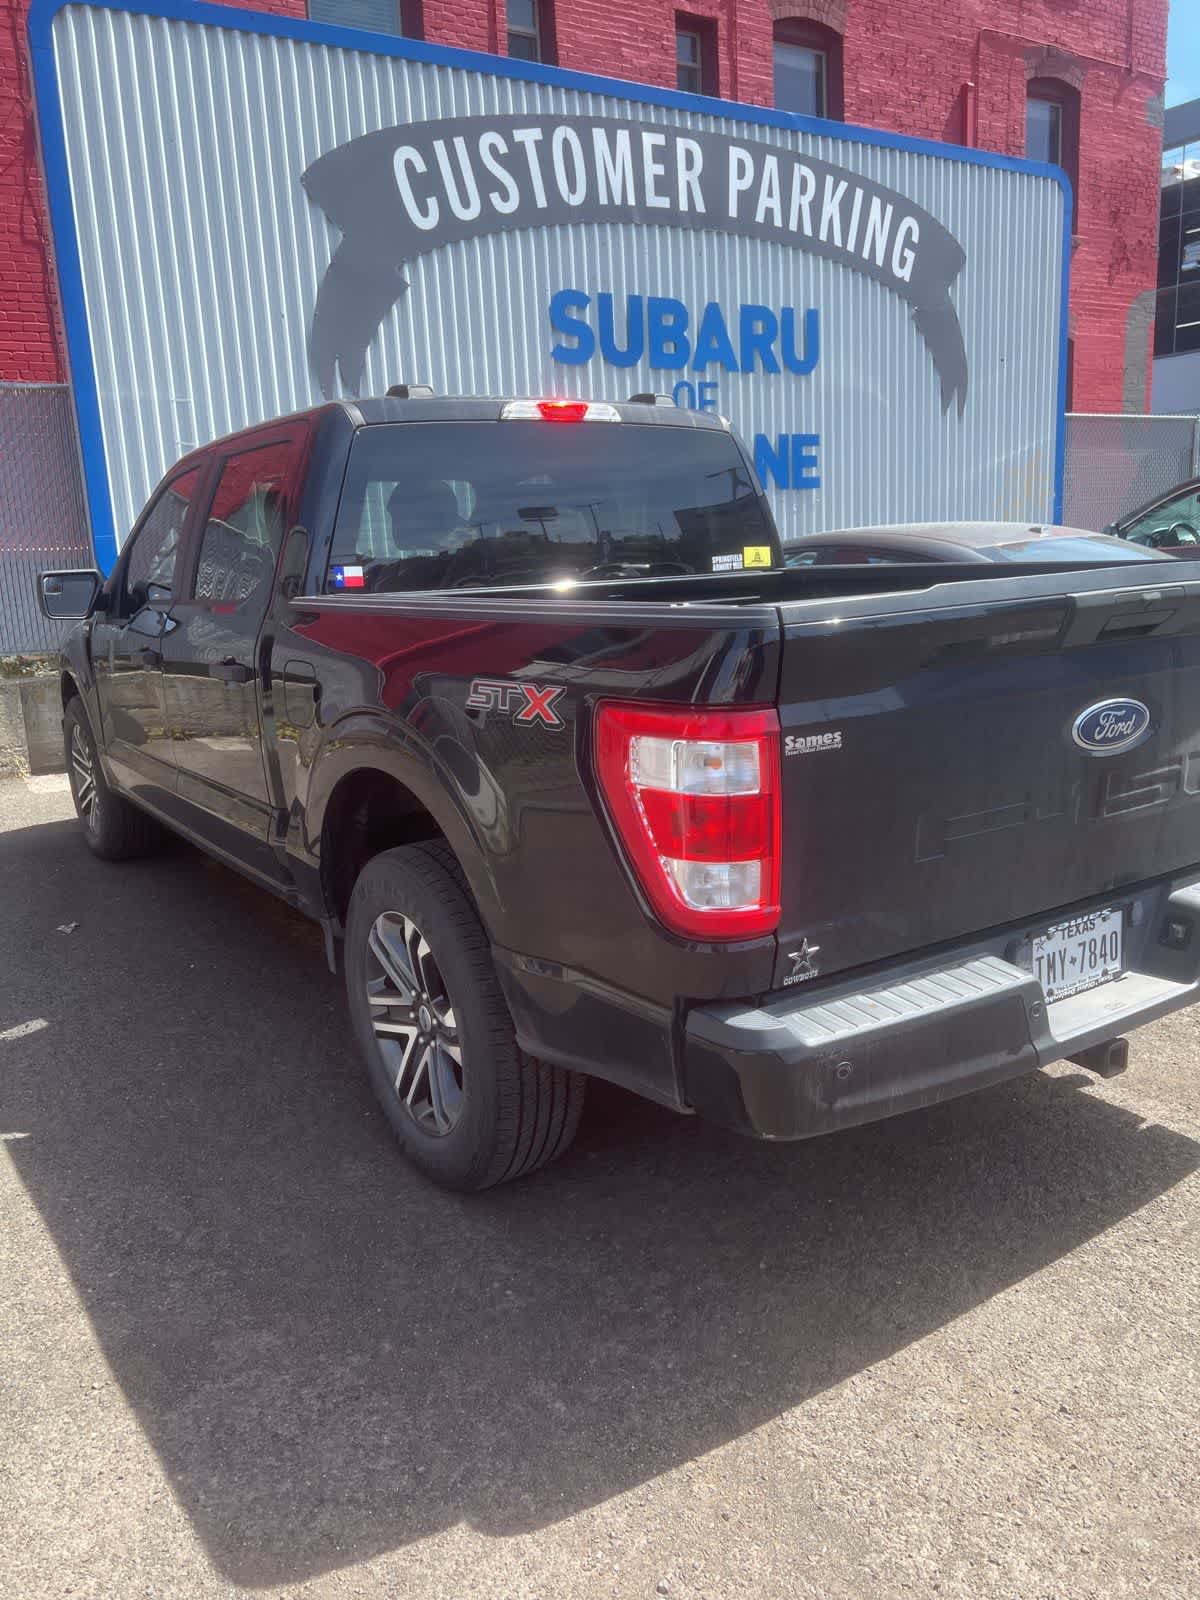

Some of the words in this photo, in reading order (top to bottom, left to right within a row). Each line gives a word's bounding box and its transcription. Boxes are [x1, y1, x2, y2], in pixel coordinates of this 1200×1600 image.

[393, 126, 706, 230] CUSTOMER
[728, 145, 920, 282] PARKING
[549, 288, 820, 376] SUBARU
[672, 380, 718, 411] OF
[465, 679, 566, 731] STX
[784, 731, 842, 751] Sames
[1094, 709, 1136, 741] Ford
[1060, 920, 1096, 940] TEXAS
